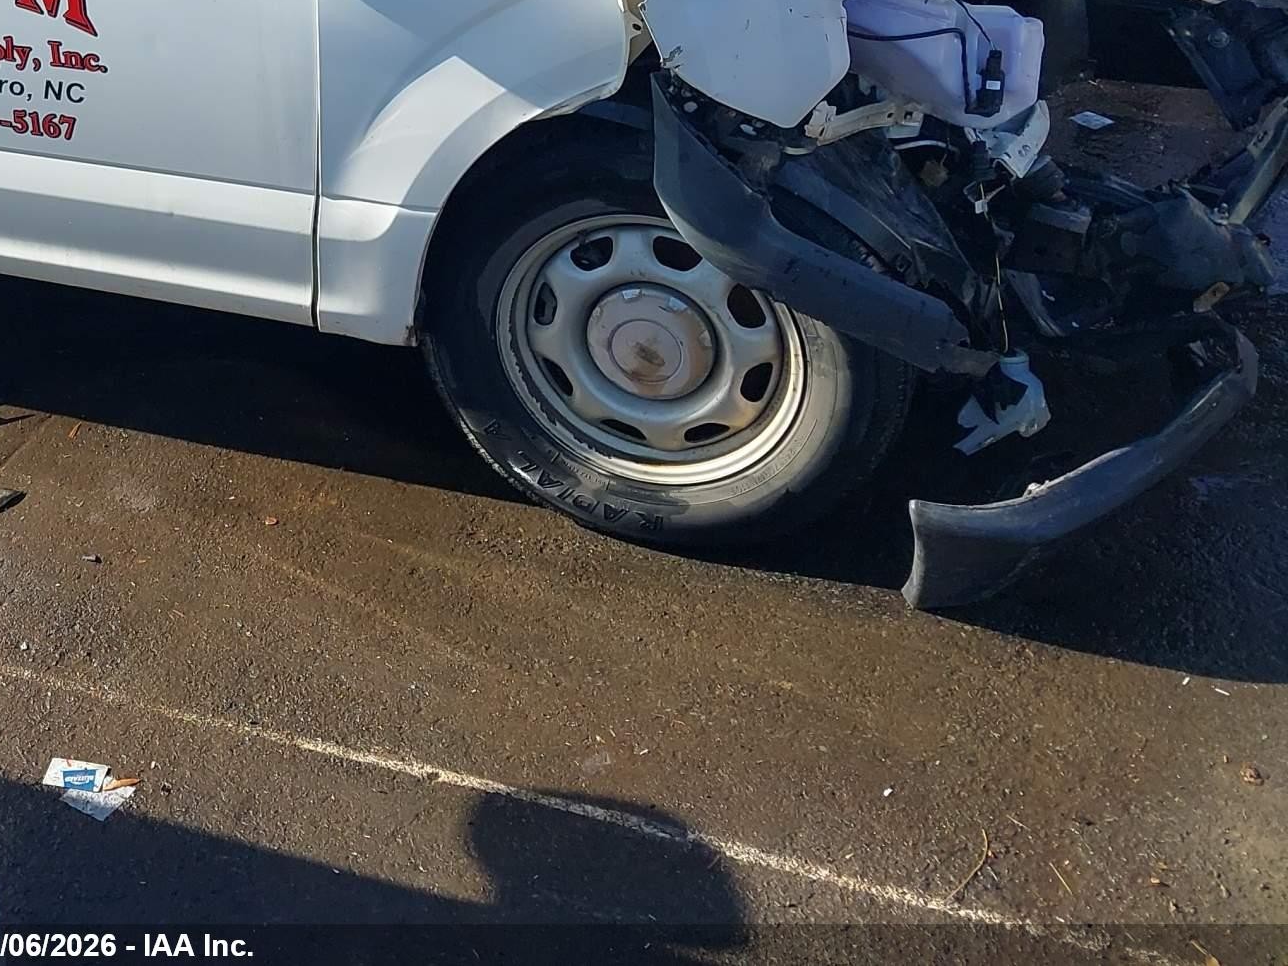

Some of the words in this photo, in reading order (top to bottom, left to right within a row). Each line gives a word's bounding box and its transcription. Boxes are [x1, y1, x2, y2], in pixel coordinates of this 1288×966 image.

[47, 40, 109, 73] Inc.
[43, 79, 86, 104] NC
[513, 449, 664, 532] RADIAL
